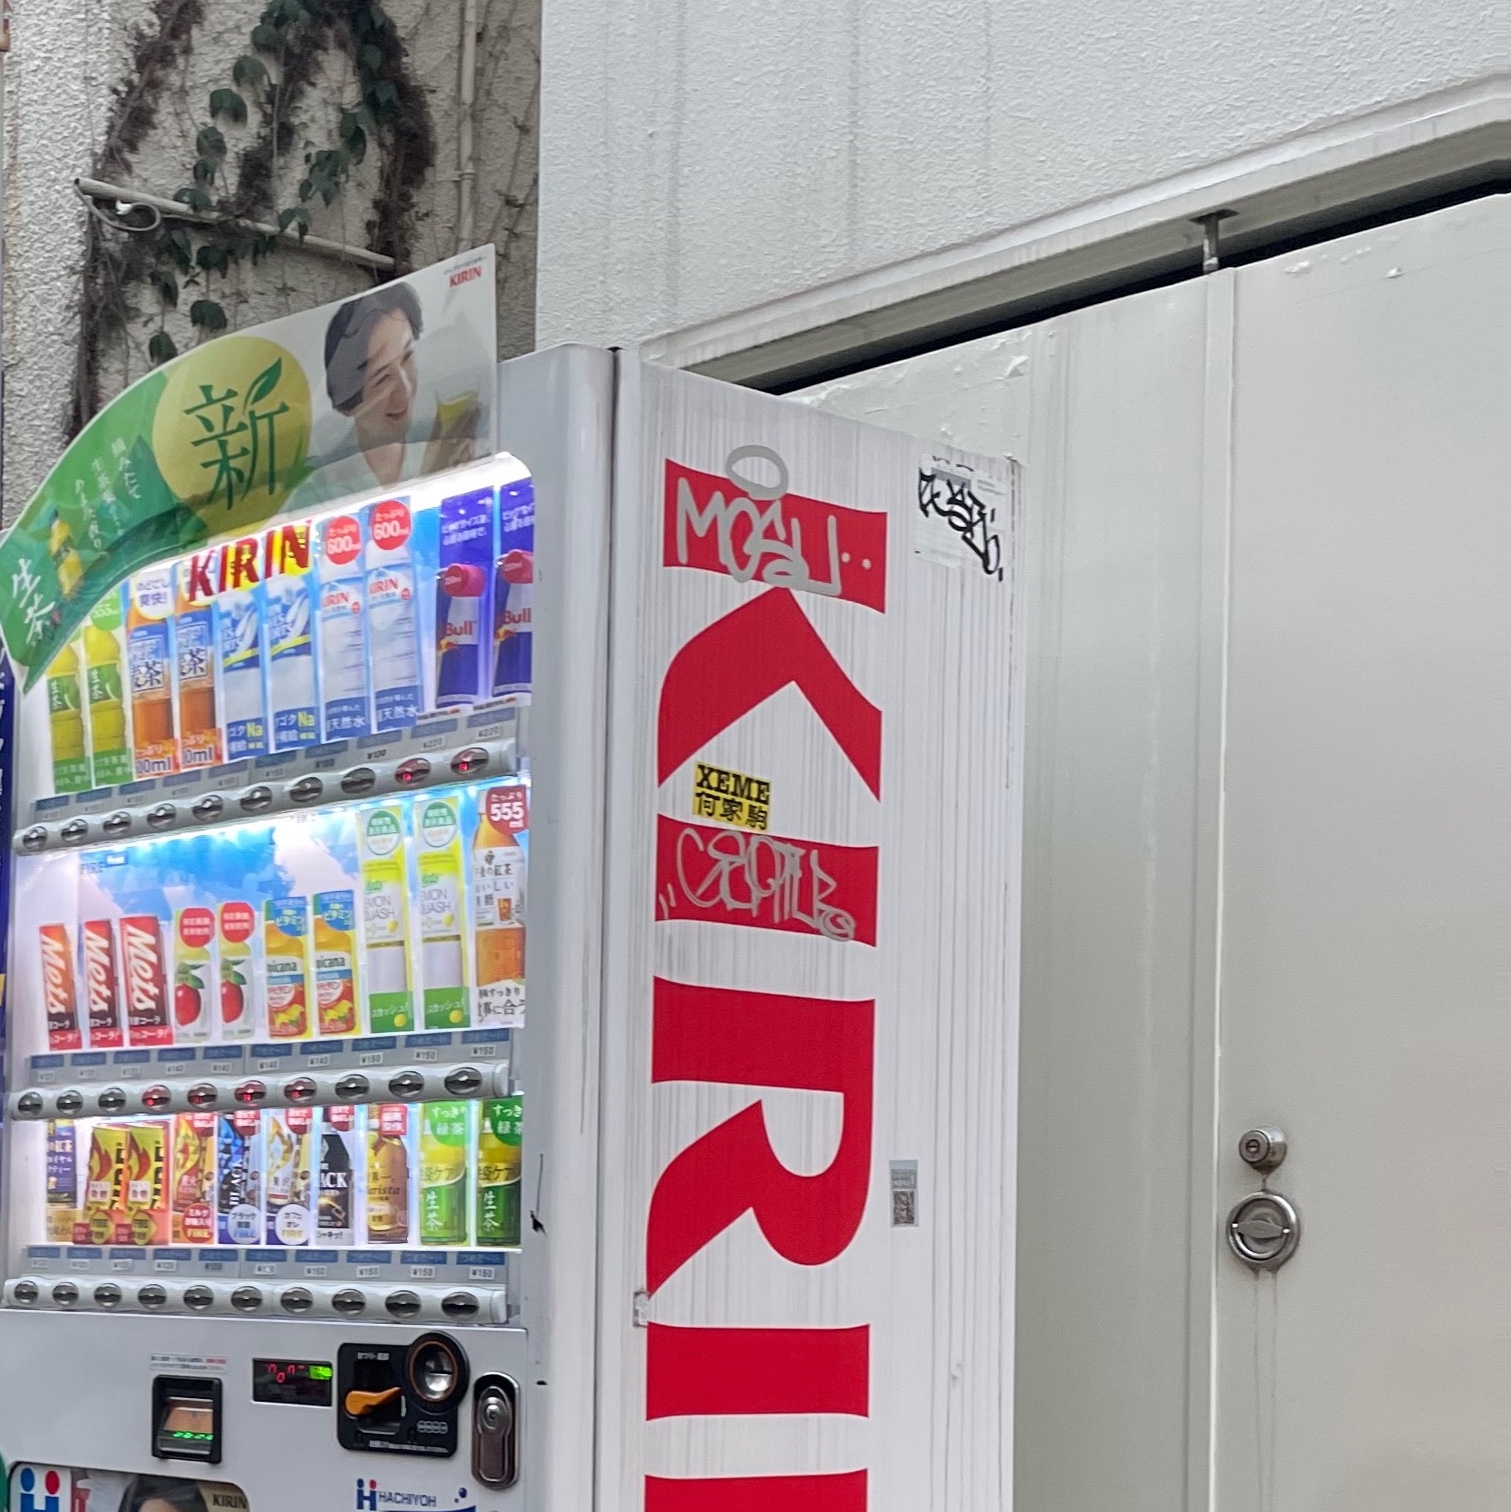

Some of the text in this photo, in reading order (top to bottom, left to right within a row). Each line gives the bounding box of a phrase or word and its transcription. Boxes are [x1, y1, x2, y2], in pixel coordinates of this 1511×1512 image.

[449, 266, 482, 288] KIRIN
[184, 357, 290, 511] 新
[189, 520, 312, 602] KIRIN
[490, 802, 525, 822] 555
[696, 763, 770, 805] XEME
[41, 933, 69, 1015] Mets
[85, 929, 112, 1013] Mets
[126, 923, 160, 1012] Mets
